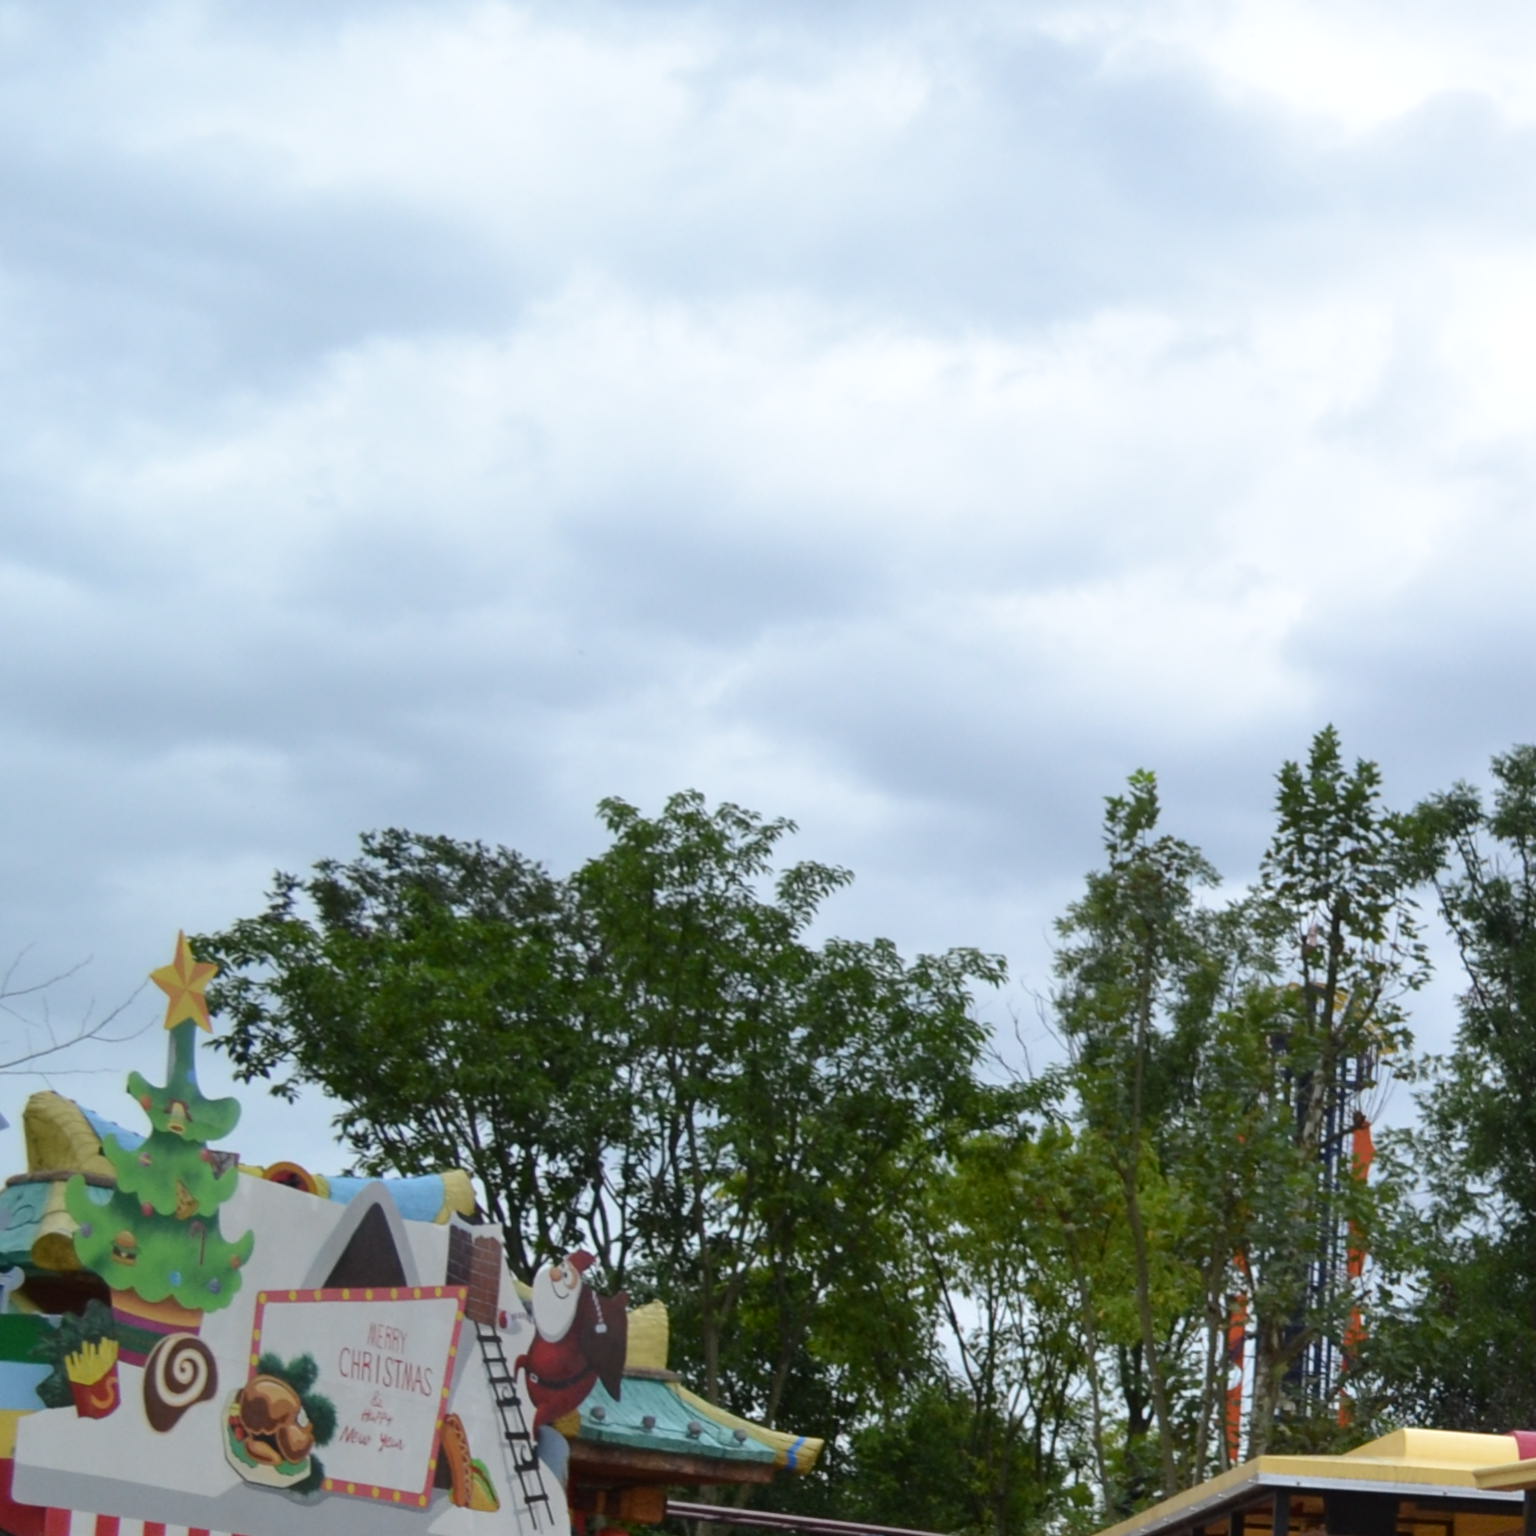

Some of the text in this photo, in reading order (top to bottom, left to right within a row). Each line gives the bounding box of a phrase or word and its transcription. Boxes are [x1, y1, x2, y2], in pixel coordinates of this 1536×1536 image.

[367, 1322, 408, 1354] MERRY
[338, 1346, 433, 1397] CHRISTMAS
[339, 1424, 372, 1447] New
